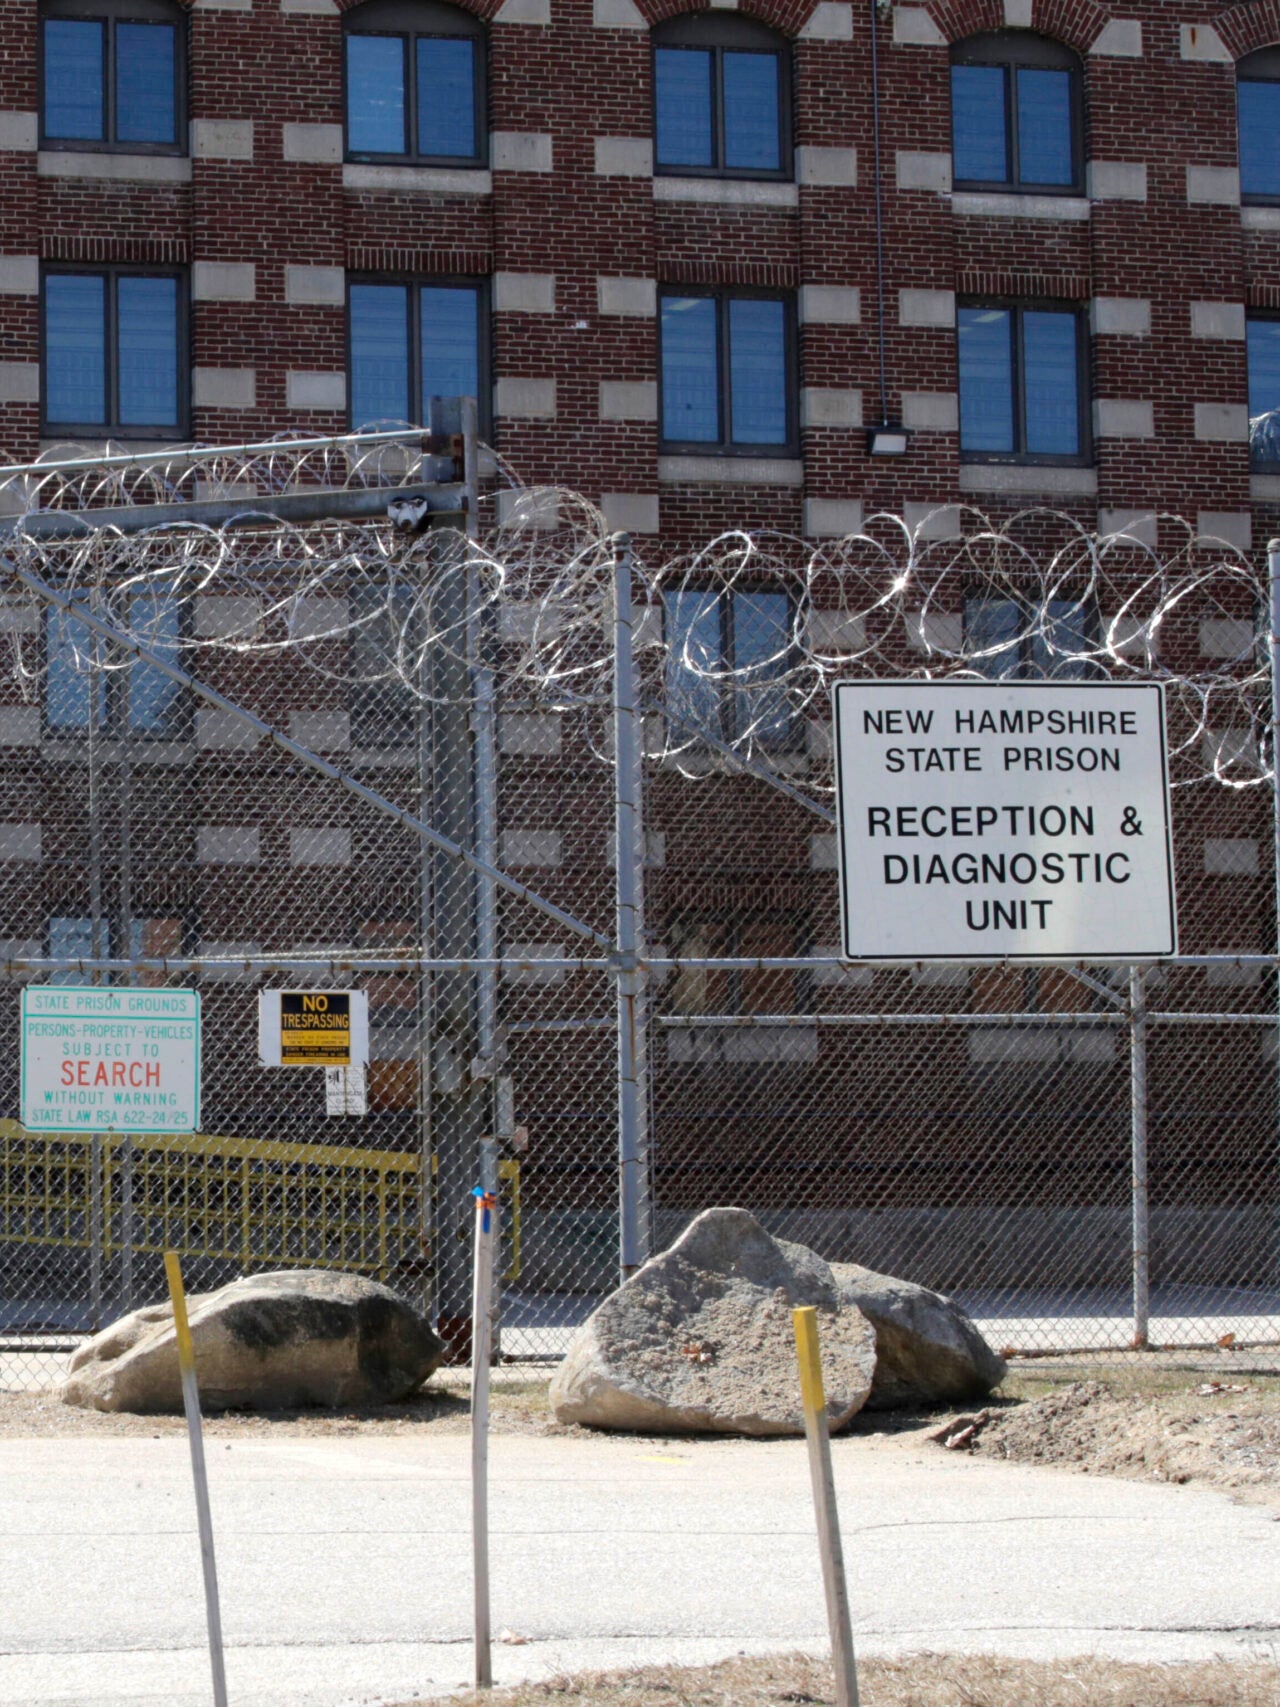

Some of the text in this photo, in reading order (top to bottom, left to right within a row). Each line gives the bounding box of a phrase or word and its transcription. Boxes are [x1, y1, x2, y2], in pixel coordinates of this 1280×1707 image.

[863, 710, 1138, 735] NEW HAMPSHIRE
[885, 747, 1120, 773] STATE PRISON
[867, 806, 1144, 837] RECEPTION &
[883, 852, 1131, 885] DIAGNOSTIC
[965, 899, 1053, 931] UNIT
[35, 995, 187, 1012] STATE PRISON GROUNDS
[302, 995, 329, 1012] NO
[282, 1013, 349, 1028] TRESPASSING
[28, 1023, 193, 1040] PERSONS-PROPERTY-VEHICLES
[62, 1042, 159, 1057] SUBJECT TO
[61, 1060, 160, 1087] SEARCH
[43, 1091, 177, 1106] WITHOUT WARNING
[32, 1109, 63, 1122] STATE
[69, 1111, 92, 1123] LAW
[97, 1111, 118, 1124] RSA
